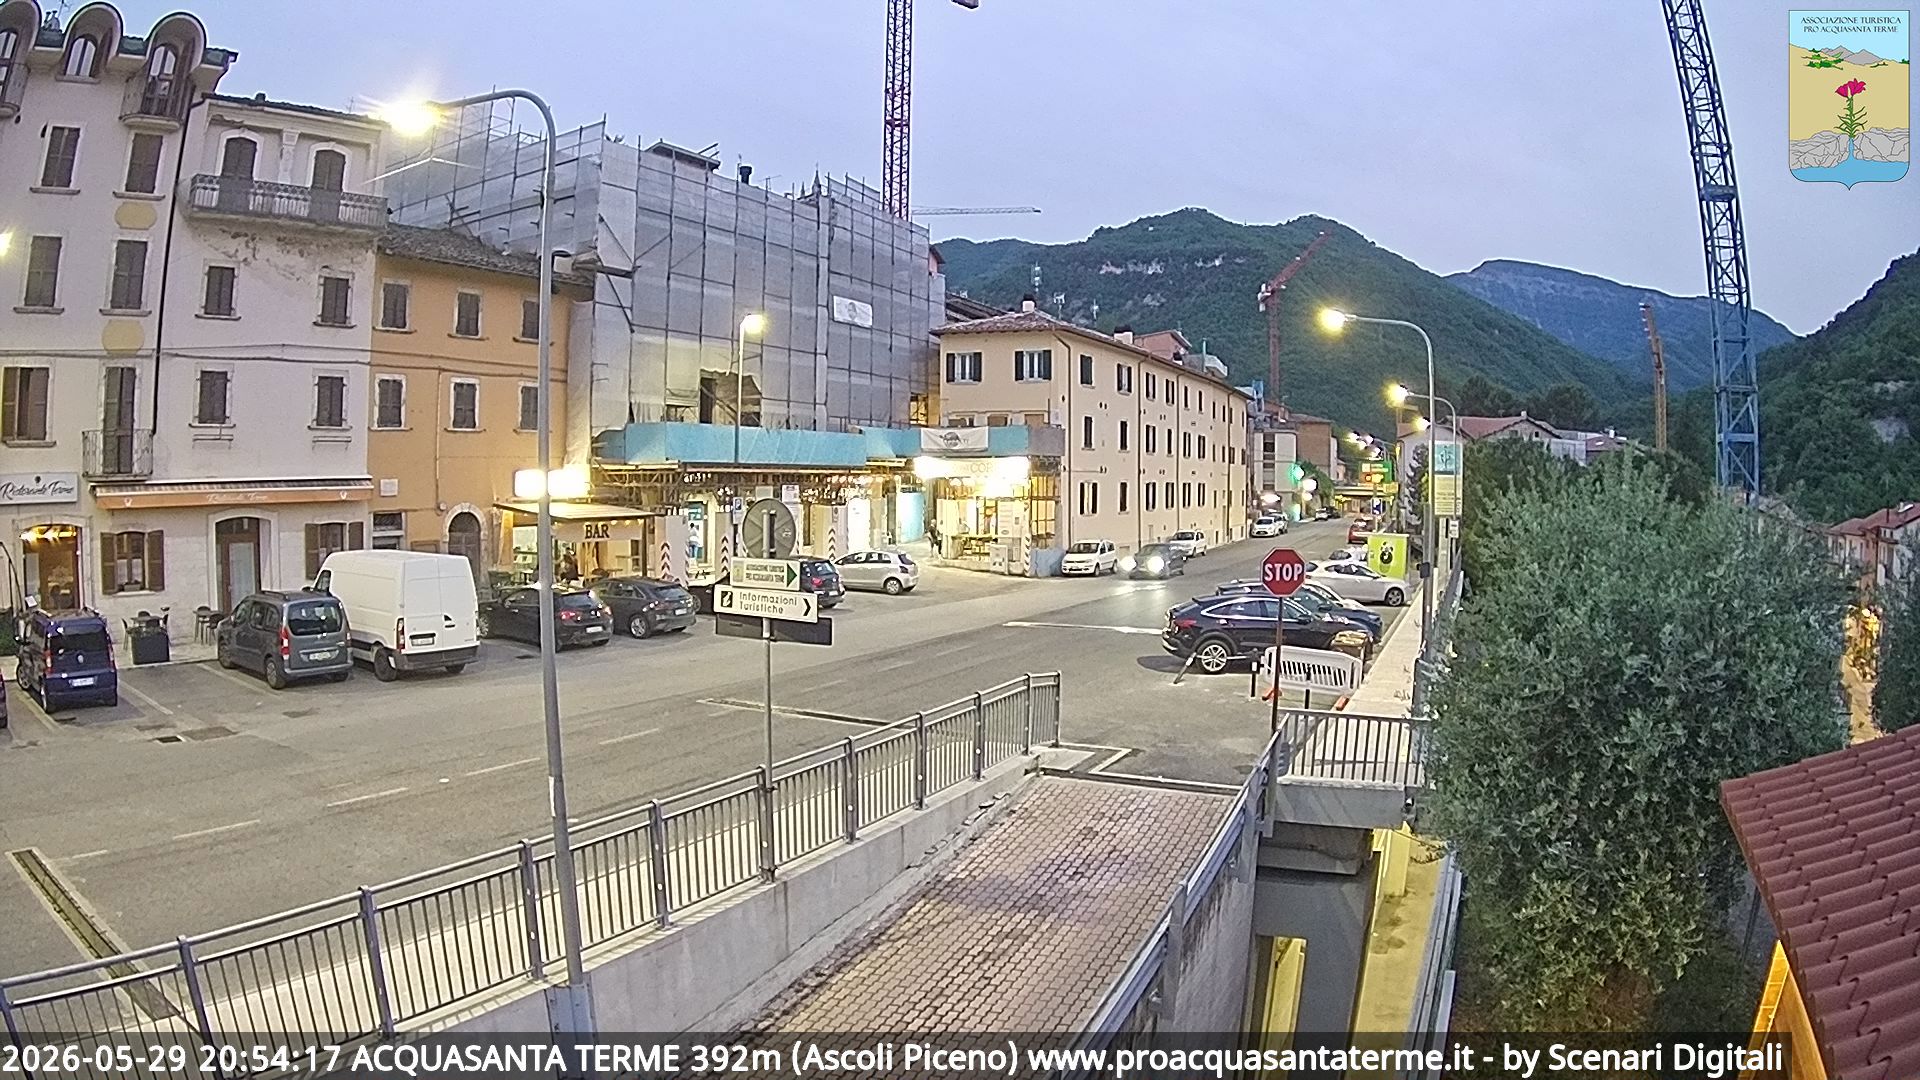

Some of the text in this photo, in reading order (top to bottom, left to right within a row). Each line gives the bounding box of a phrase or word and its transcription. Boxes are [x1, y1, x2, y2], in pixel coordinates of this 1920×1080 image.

[585, 524, 610, 539] BAR
[1264, 563, 1303, 581] STOP
[740, 592, 797, 606] Informazioni
[740, 601, 784, 614] Turistiche
